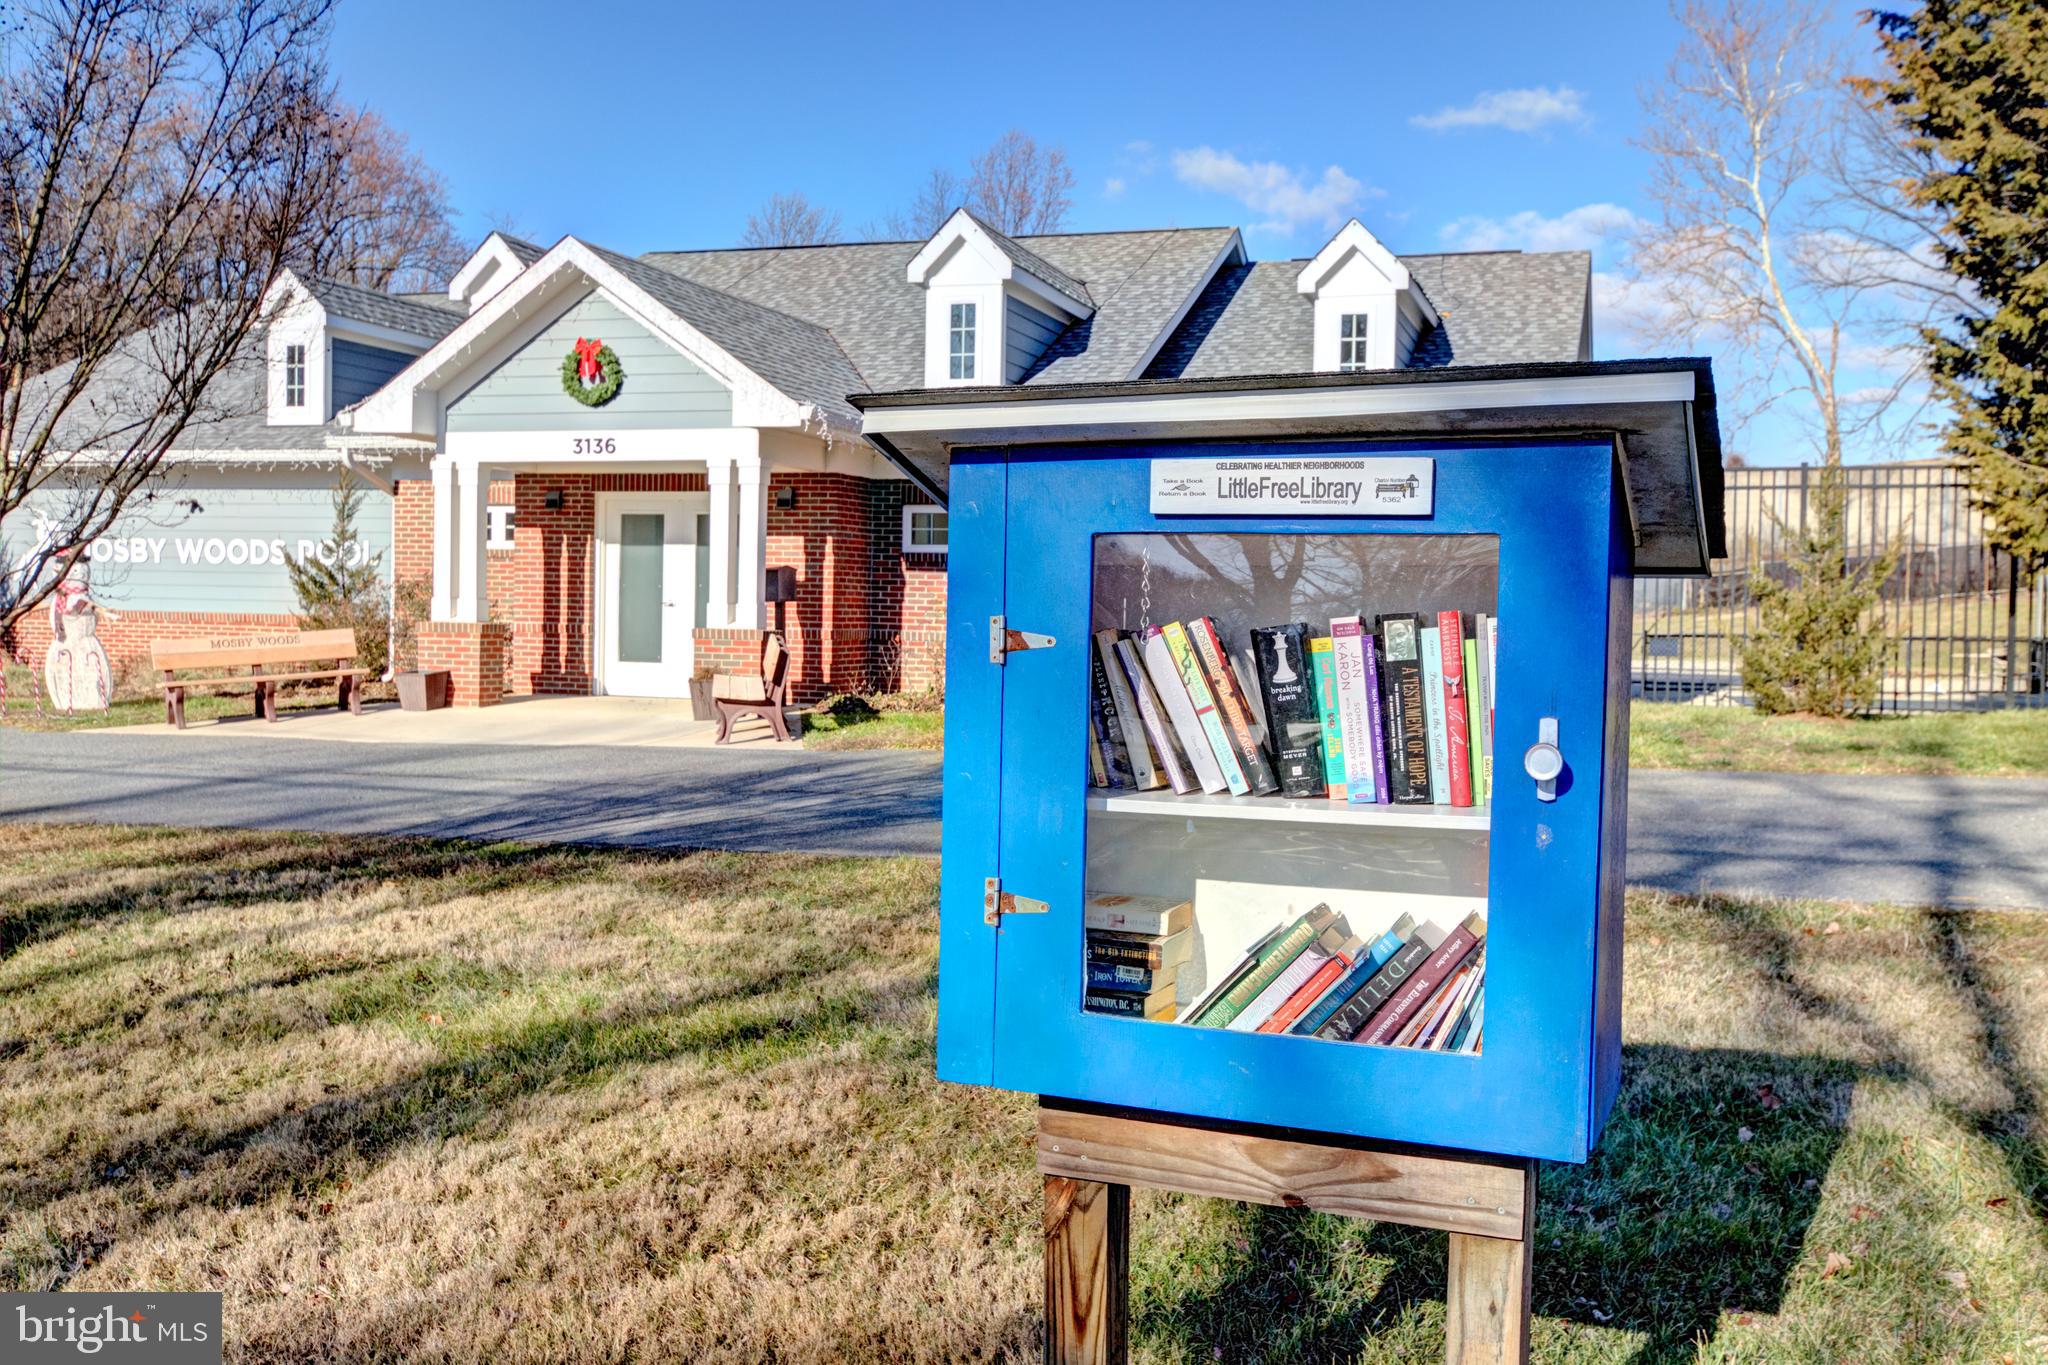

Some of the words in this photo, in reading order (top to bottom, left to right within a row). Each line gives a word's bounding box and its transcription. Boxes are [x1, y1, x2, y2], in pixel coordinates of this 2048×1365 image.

[573, 438, 616, 454] 3136
[1216, 462, 1263, 470] CELEBRATING
[1264, 462, 1302, 470] HEALTHIER
[1303, 461, 1365, 470] NEIGHBORHOODS
[1218, 476, 1362, 504] LittleFreeLibrary
[86, 538, 167, 564] OSBY
[175, 538, 286, 566] WOODS
[211, 637, 253, 649] MOSBY
[256, 634, 301, 646] WOODS
[1194, 622, 1222, 677] ROSENBERG
[1440, 618, 1451, 665] AMBROSE
[1449, 617, 1458, 658] STEPHEN
[1337, 642, 1351, 690] KARON
[1349, 652, 1361, 678] JAN
[1401, 666, 1418, 674] A
[1270, 684, 1302, 695] breaking
[1277, 694, 1297, 702] dawn
[1428, 671, 1439, 705] Princess
[1371, 703, 1379, 723] TRANG
[1402, 676, 1422, 738] TESTAMENT
[1447, 704, 1462, 721] To
[1224, 699, 1243, 730] THIRD
[1237, 729, 1258, 767] TARGET
[1345, 712, 1356, 760] SOMEBODY
[1353, 702, 1365, 757] SOMEWHERE
[1432, 717, 1441, 730] the
[1406, 739, 1424, 755] OF
[1432, 731, 1445, 771] Spotlight
[1449, 725, 1467, 781] America
[1350, 763, 1359, 789] GOOD
[1358, 760, 1367, 783] SAFE
[1408, 757, 1426, 785] HOPE
[1433, 951, 1450, 969] Archer
[1094, 971, 1112, 981] IRON
[1414, 977, 1429, 992] THE
[1393, 988, 1420, 1016] ELEVENTH
